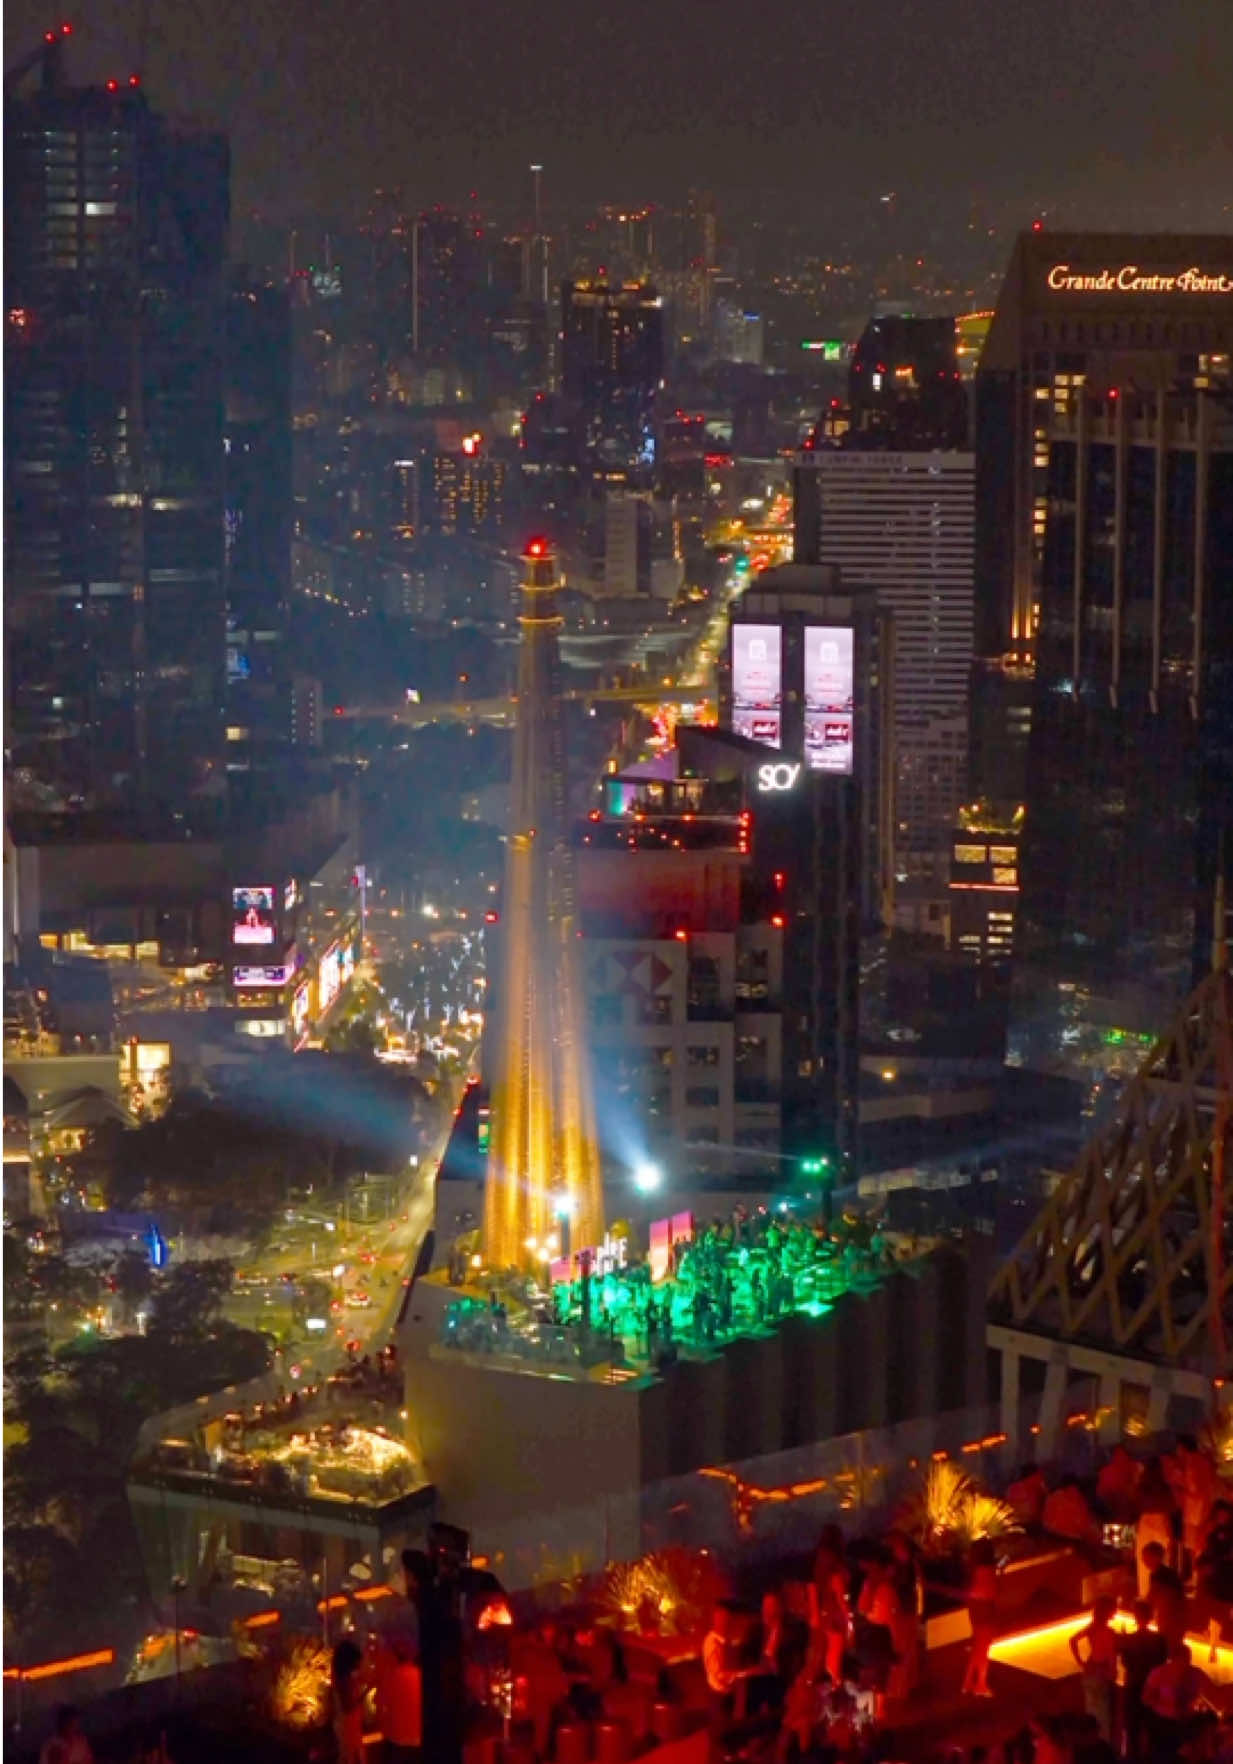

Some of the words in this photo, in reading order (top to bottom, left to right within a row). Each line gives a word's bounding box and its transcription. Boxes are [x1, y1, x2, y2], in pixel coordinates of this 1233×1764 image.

[1048, 265, 1115, 290] Grande
[1116, 266, 1175, 291] Centre
[1176, 266, 1233, 292] Point
